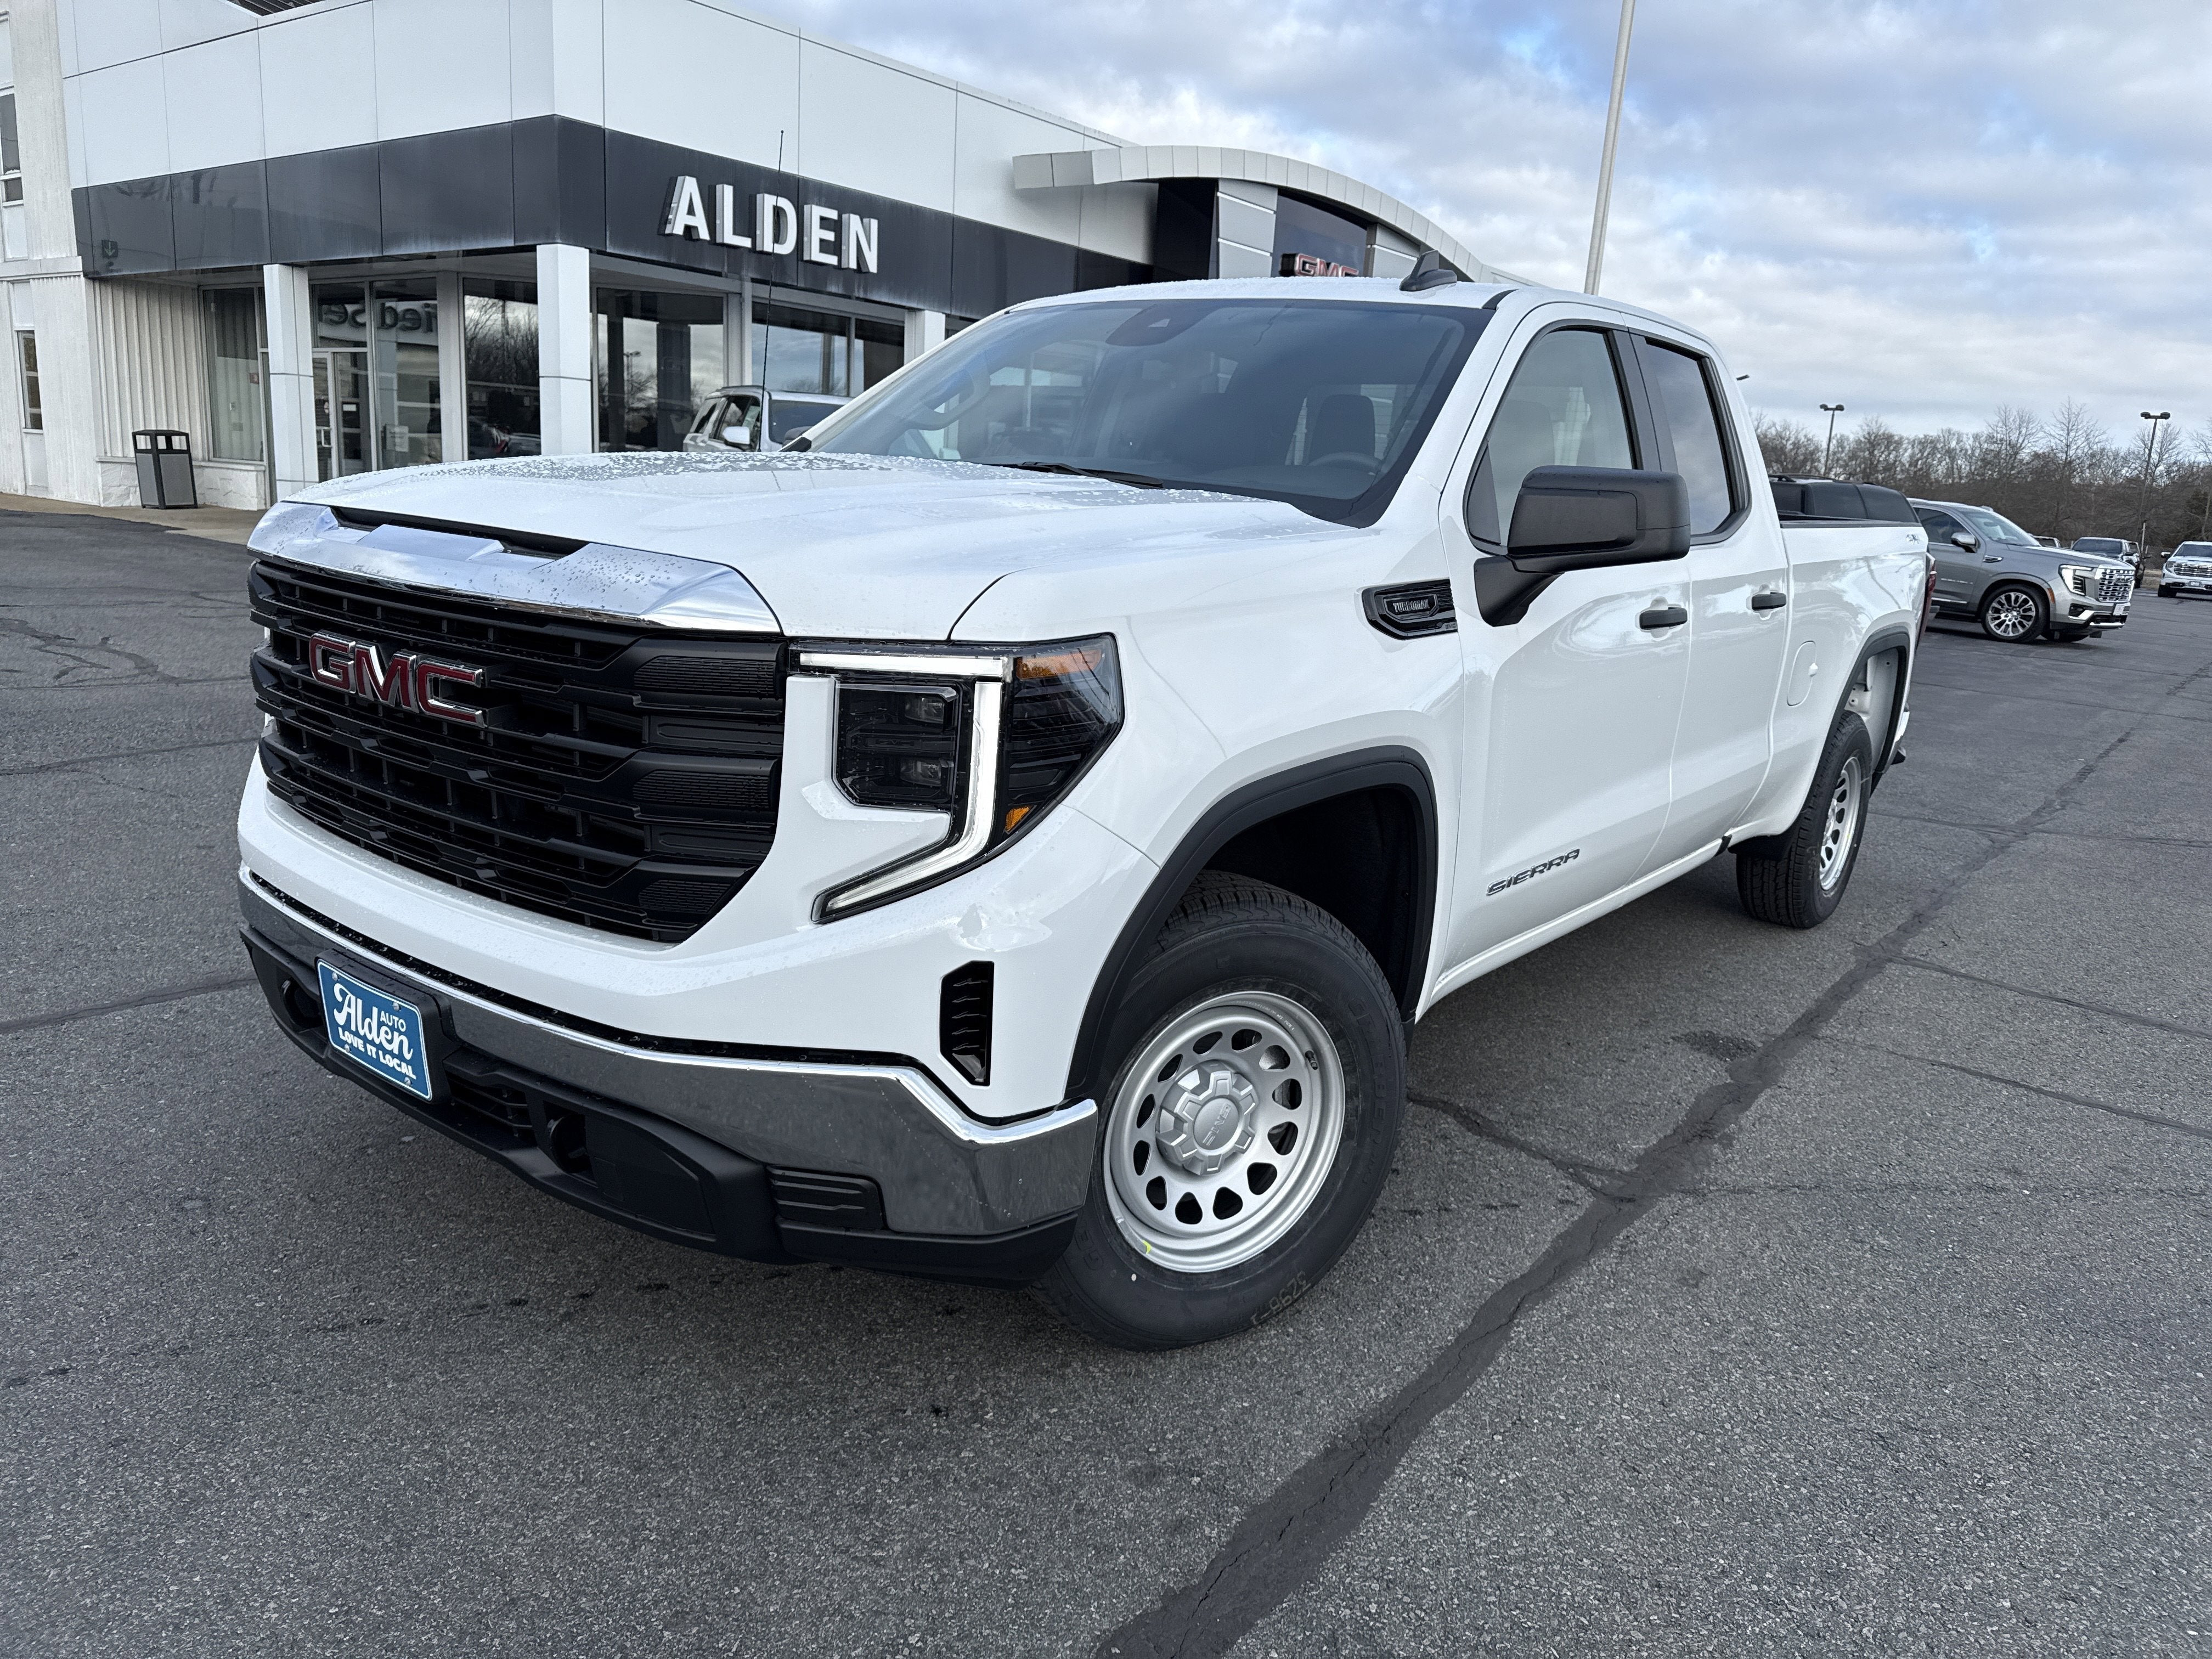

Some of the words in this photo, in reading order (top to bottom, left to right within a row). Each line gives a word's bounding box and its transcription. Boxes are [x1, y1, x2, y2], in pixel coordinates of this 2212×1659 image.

[665, 176, 878, 273] ALDEN
[1392, 599, 1430, 613] TURBOMAX
[309, 631, 487, 728] GMC
[1486, 848, 1580, 896] SIERRA
[334, 983, 413, 1060] Alden
[380, 1011, 406, 1032] AUTO
[338, 1026, 365, 1052] LOVE
[366, 1043, 376, 1059] IT
[379, 1049, 416, 1080] LOCAL
